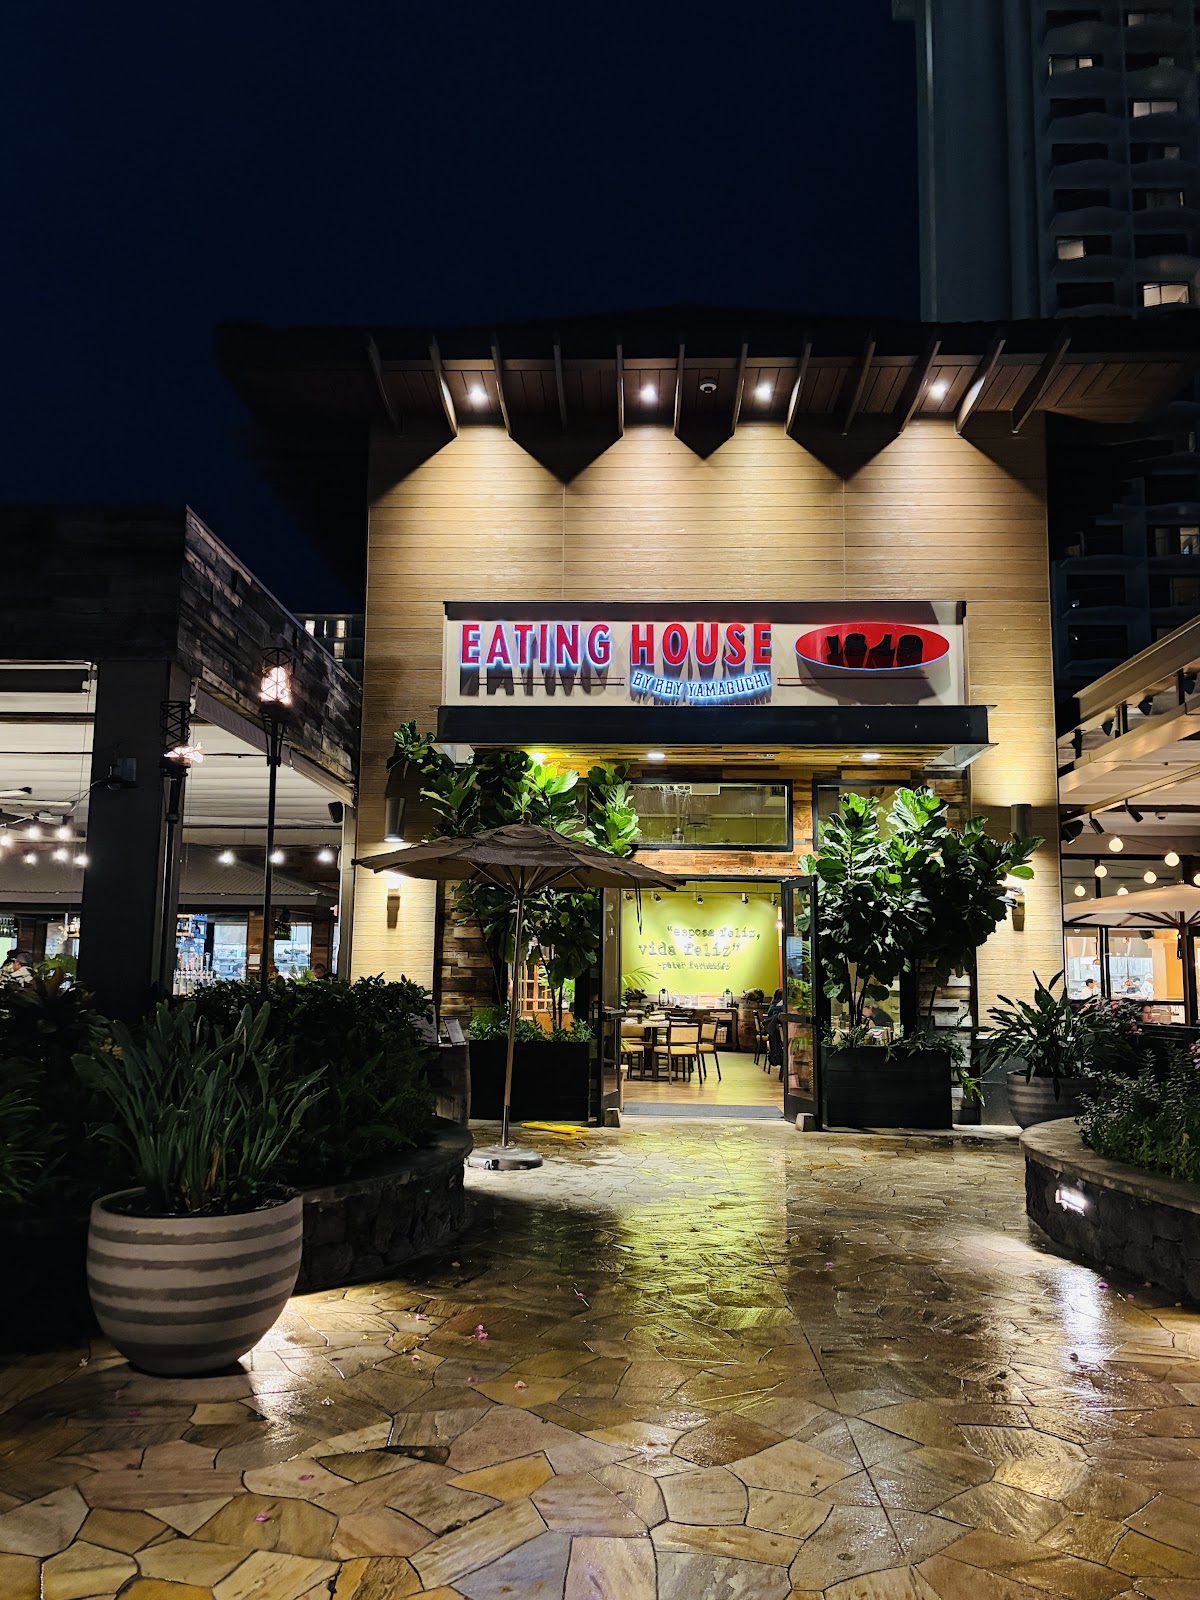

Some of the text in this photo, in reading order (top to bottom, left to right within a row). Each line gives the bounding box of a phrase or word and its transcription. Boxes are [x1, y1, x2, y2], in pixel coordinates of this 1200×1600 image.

[460, 622, 612, 666] EATING
[630, 622, 772, 666] HOUSE
[632, 671, 653, 690] BY
[687, 671, 770, 697] YAMAGUCHI
[637, 940, 677, 956] vida
